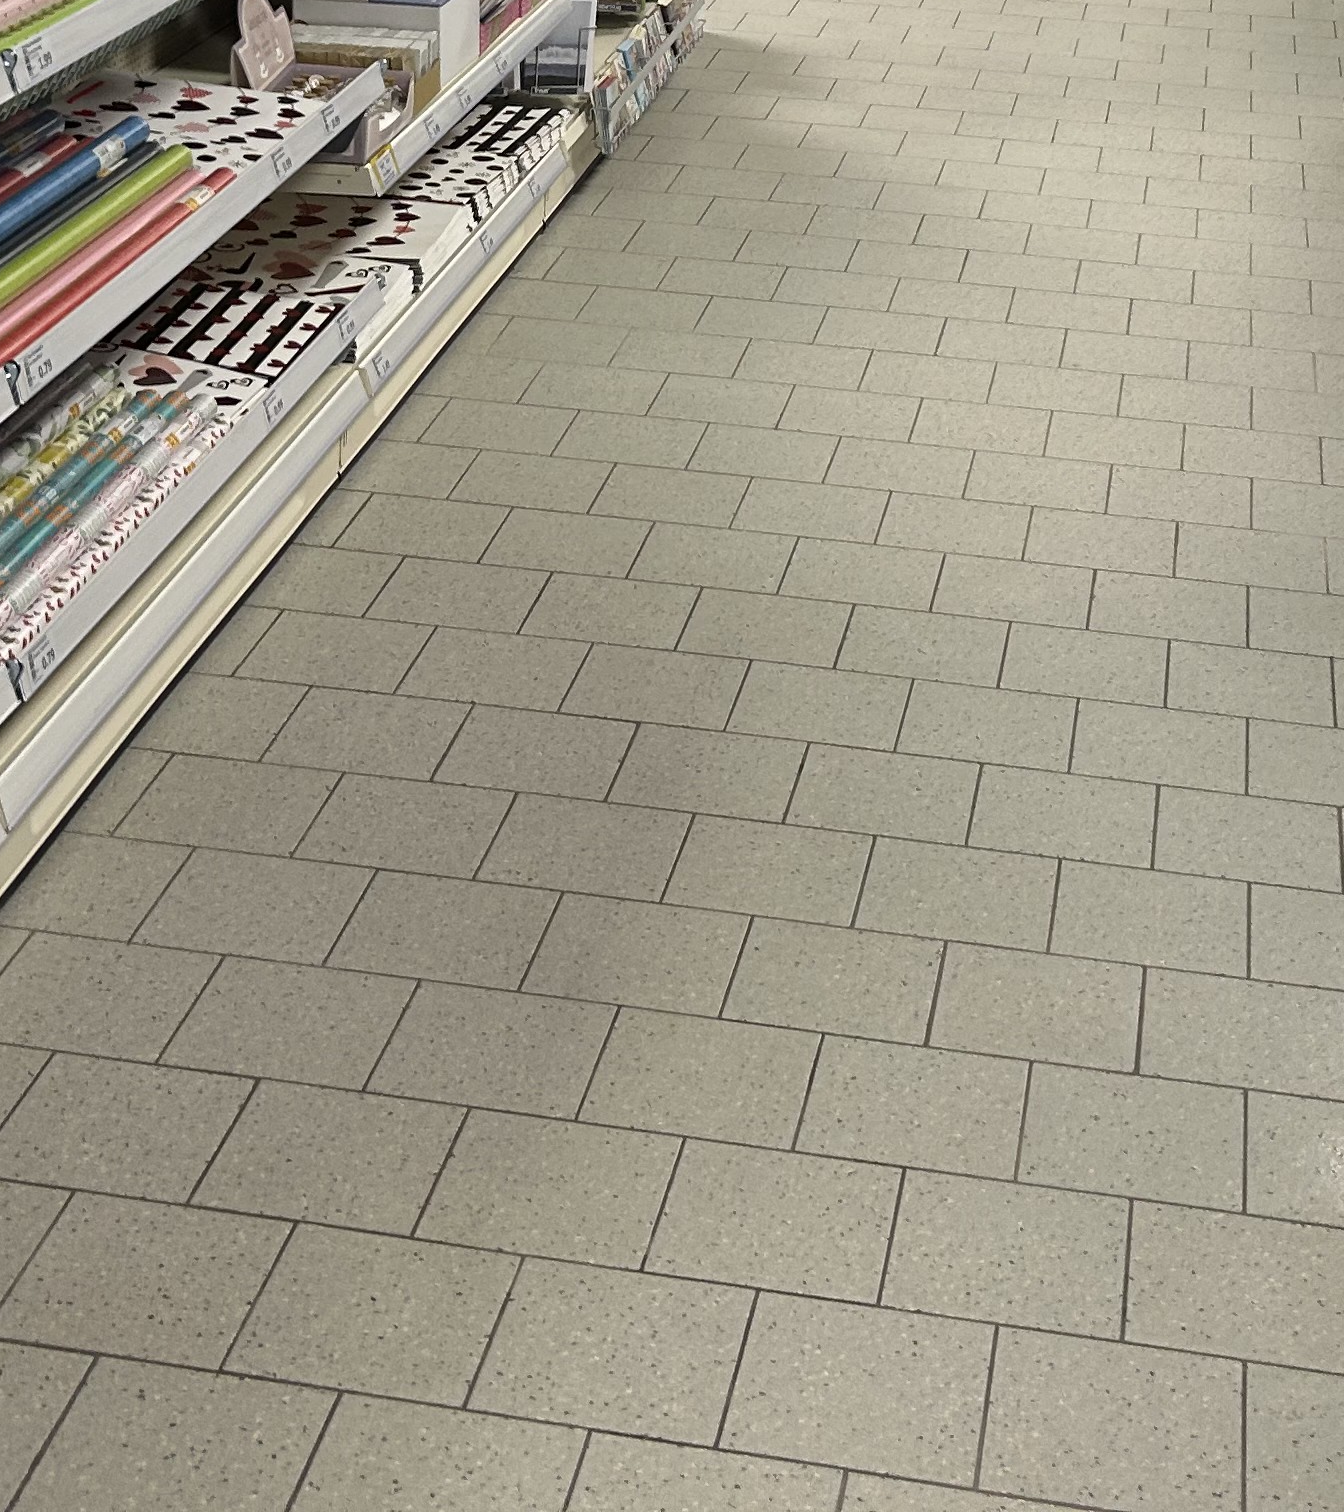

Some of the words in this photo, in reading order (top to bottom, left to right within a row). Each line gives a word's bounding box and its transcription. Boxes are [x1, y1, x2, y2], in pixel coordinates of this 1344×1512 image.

[37, 50, 53, 69] 1.99
[38, 358, 53, 378] 0.79
[42, 648, 56, 670] 0.79
